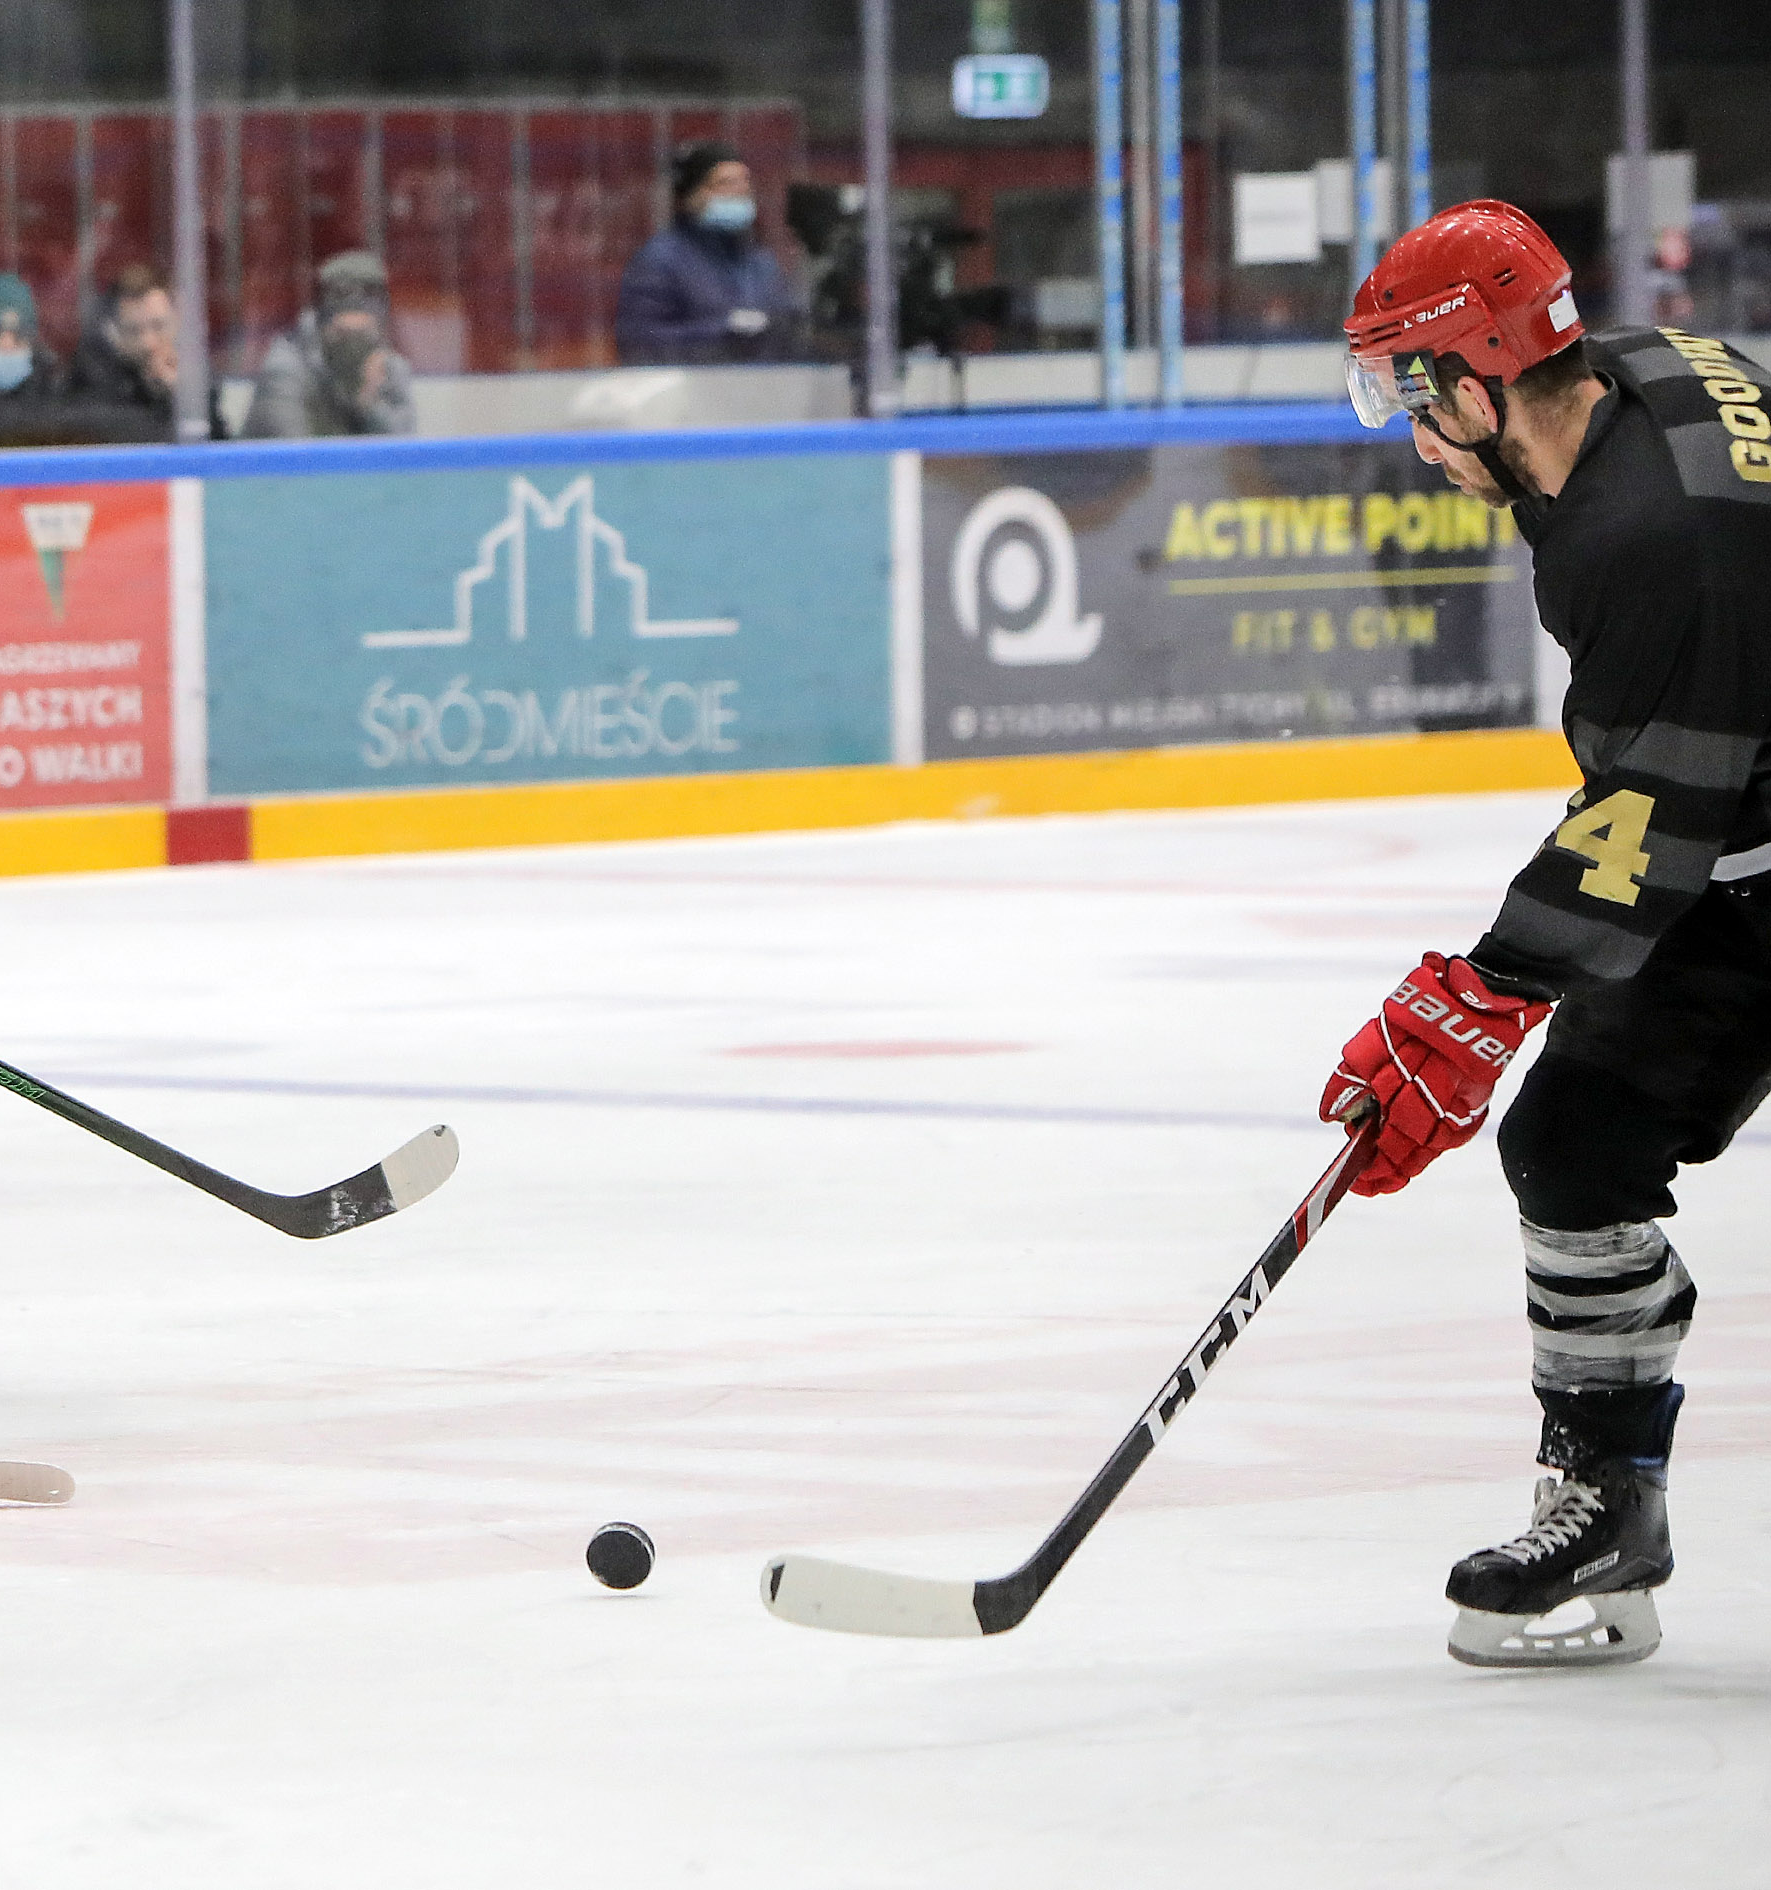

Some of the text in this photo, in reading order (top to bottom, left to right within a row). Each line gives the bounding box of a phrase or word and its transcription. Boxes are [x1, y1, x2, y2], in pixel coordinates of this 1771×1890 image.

[1163, 494, 1353, 560] ACTIVE
[31, 740, 144, 785] WALKI
[1140, 1264, 1271, 1446] CCM
